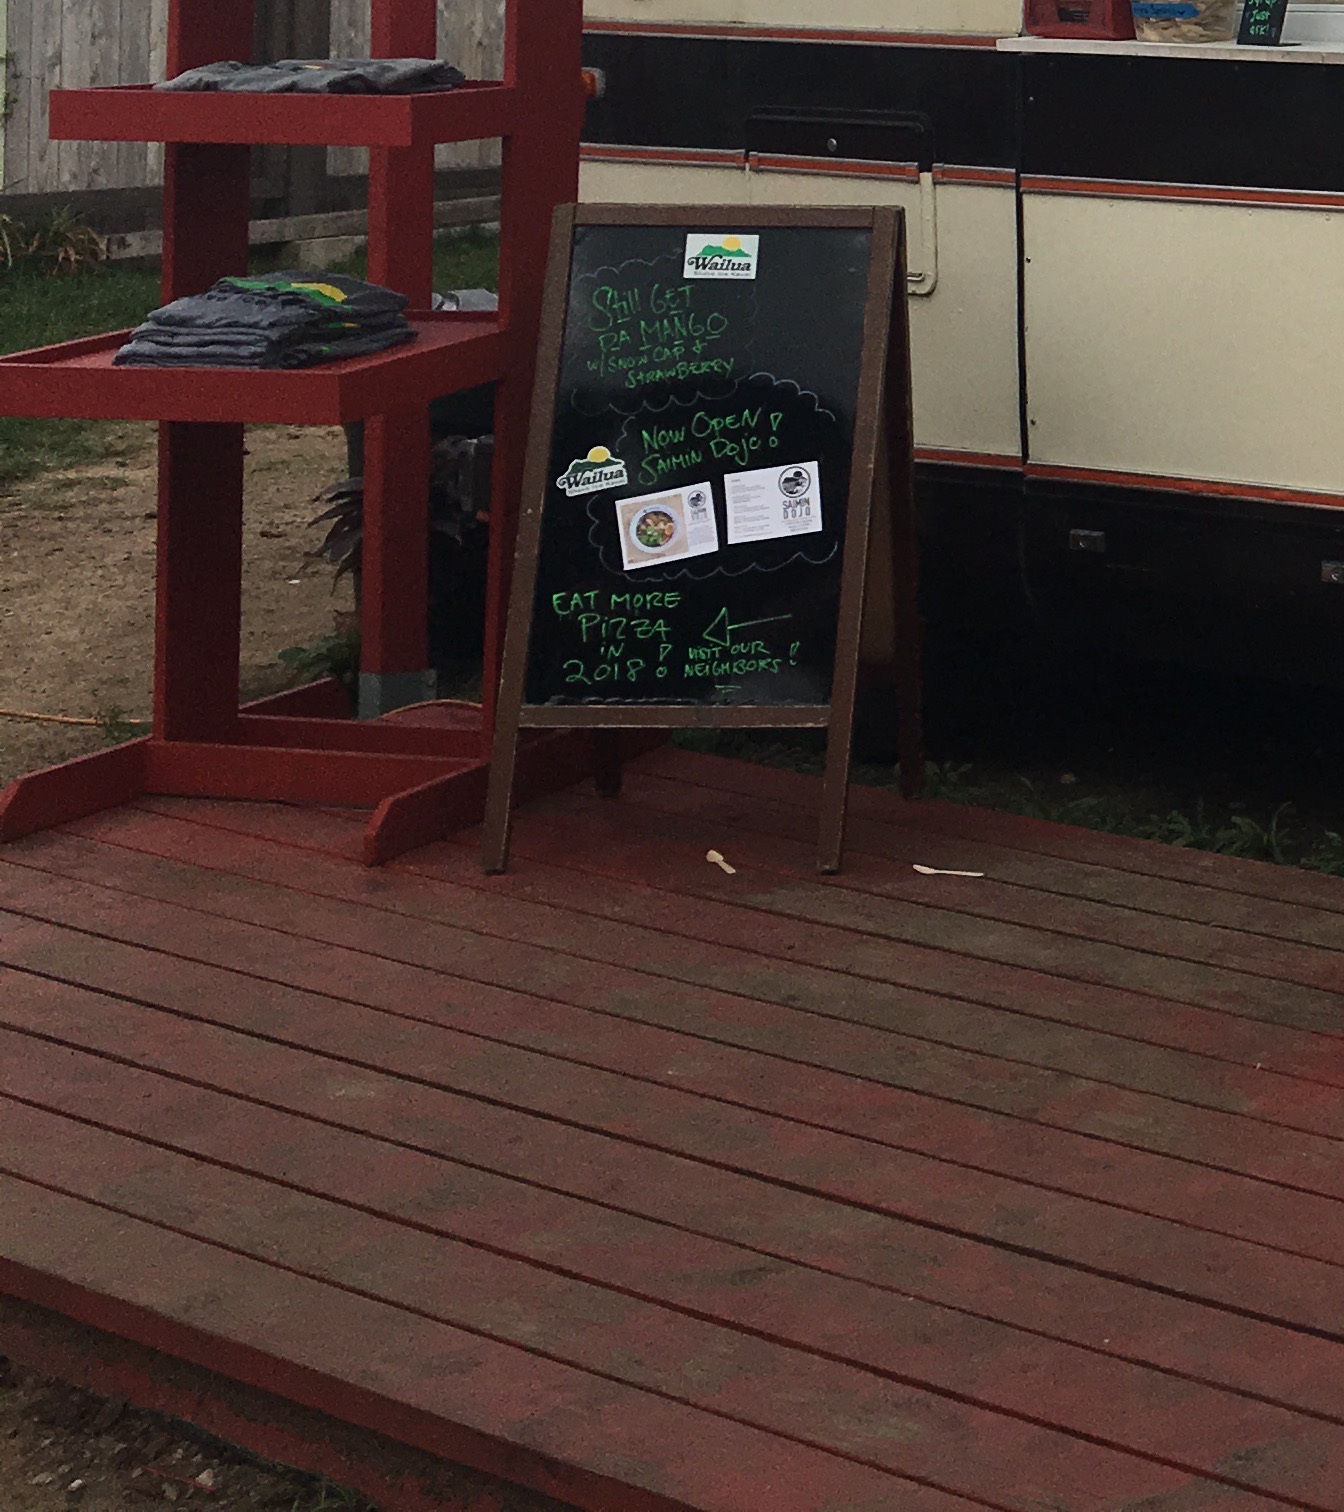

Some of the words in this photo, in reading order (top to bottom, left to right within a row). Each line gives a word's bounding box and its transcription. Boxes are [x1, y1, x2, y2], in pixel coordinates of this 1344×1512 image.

[687, 254, 752, 271] Wailua
[651, 284, 694, 314] GET
[640, 313, 728, 346] MANGO
[559, 468, 624, 490] Wailua
[552, 590, 599, 615] EAT
[611, 591, 680, 611] MORE
[730, 640, 770, 659] OUR
[562, 659, 645, 685] 2018
